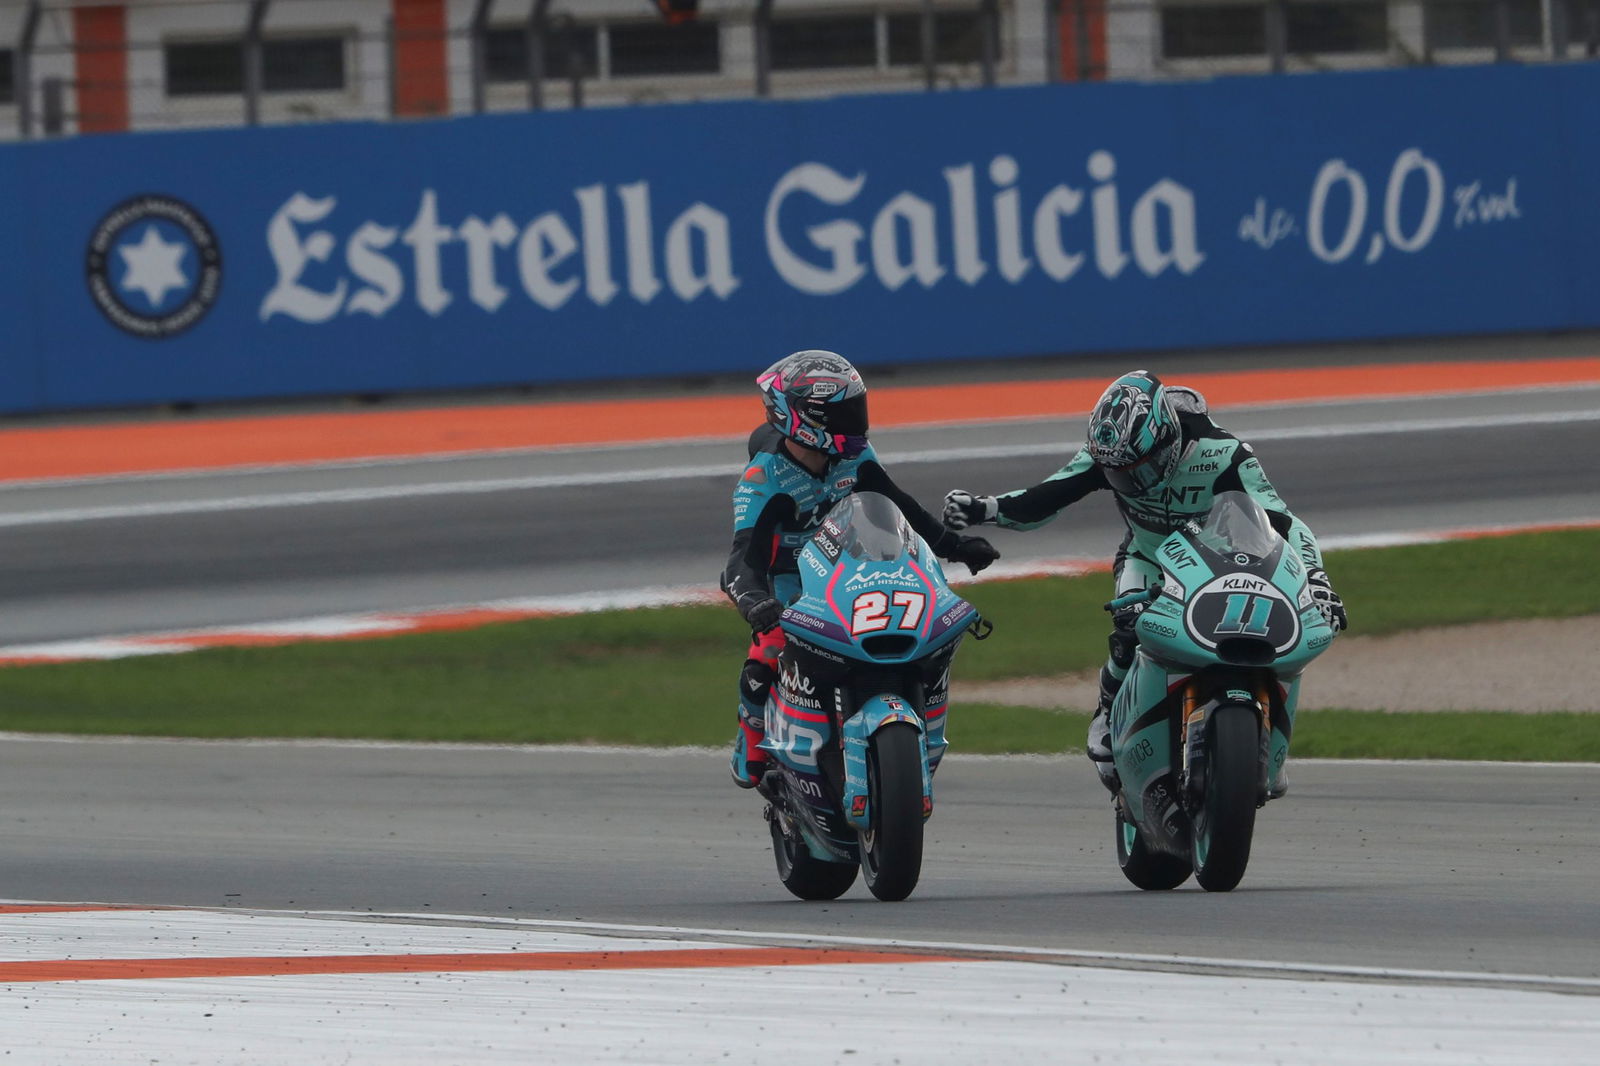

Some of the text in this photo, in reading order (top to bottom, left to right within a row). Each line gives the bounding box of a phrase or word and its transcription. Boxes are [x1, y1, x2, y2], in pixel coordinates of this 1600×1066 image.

[259, 181, 741, 324] Estrella
[765, 150, 1205, 296] Galicia
[1306, 147, 1444, 265] 0,0
[1200, 445, 1232, 459] KLINT
[1189, 461, 1219, 473] intek
[823, 519, 843, 536] WRS
[814, 531, 840, 558] gaviota
[1162, 538, 1199, 570] KLINT
[801, 549, 828, 578] CFMOTO
[844, 563, 919, 586] inde
[1222, 578, 1267, 592] KLINT
[845, 579, 921, 593] SOLER HISPANIA
[791, 611, 826, 630] solunion
[851, 590, 927, 636] 27
[1213, 593, 1274, 637] 11
[785, 690, 822, 709] HISPANIA
